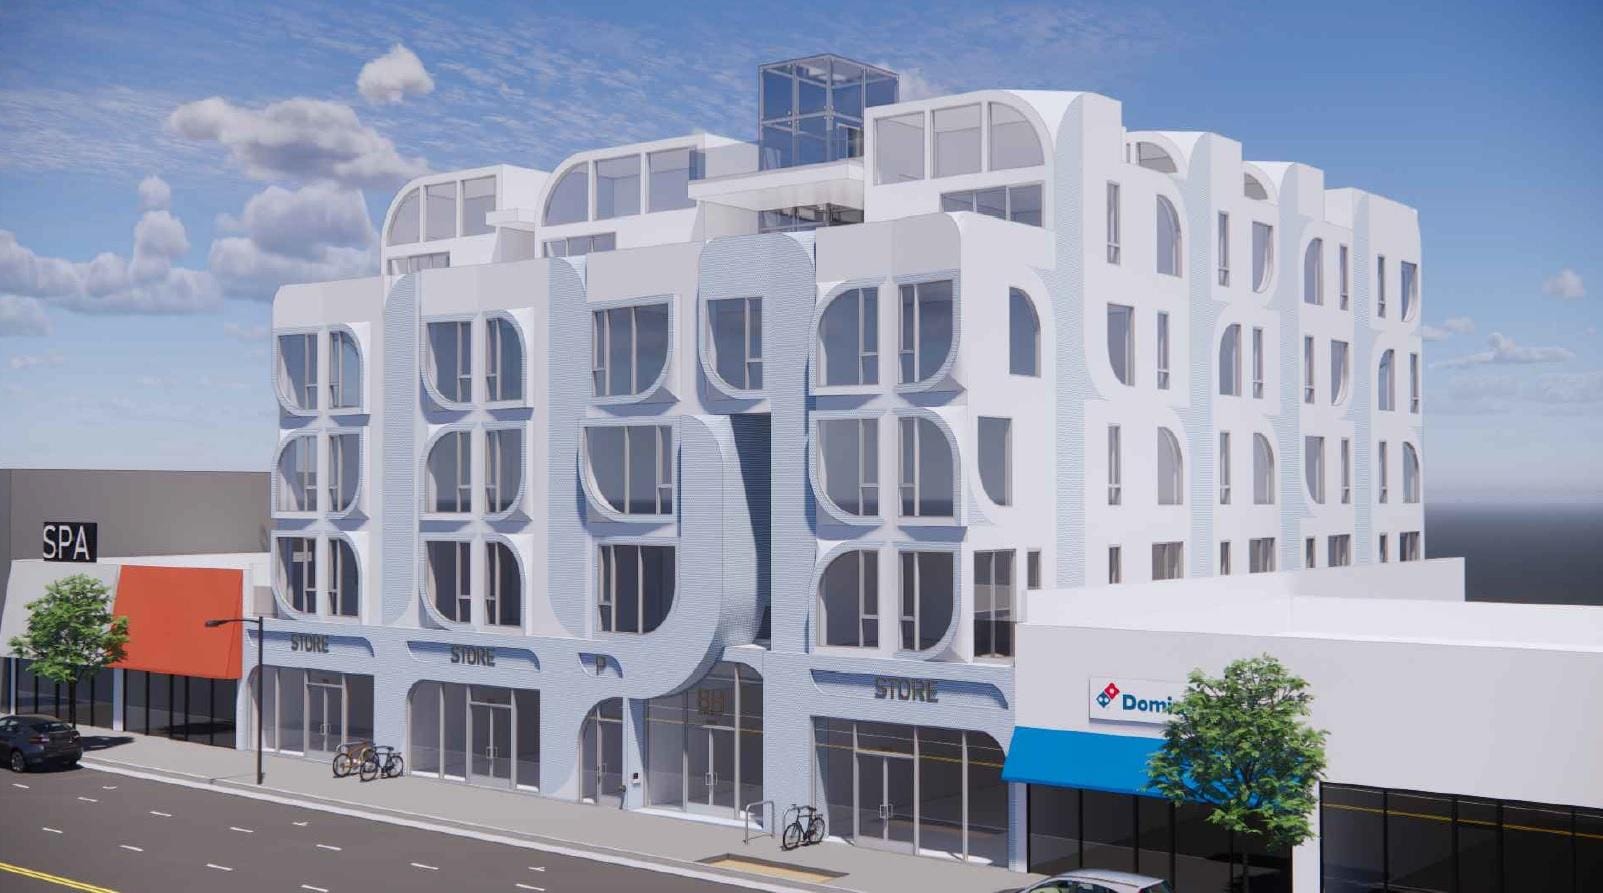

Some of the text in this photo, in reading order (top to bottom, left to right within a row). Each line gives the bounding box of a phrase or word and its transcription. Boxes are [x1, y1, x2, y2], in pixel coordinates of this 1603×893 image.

[43, 525, 90, 560] SPA
[291, 633, 329, 653] STORE
[451, 644, 496, 667] STORE
[874, 675, 939, 703] STORE
[1122, 694, 1174, 715] Domi
